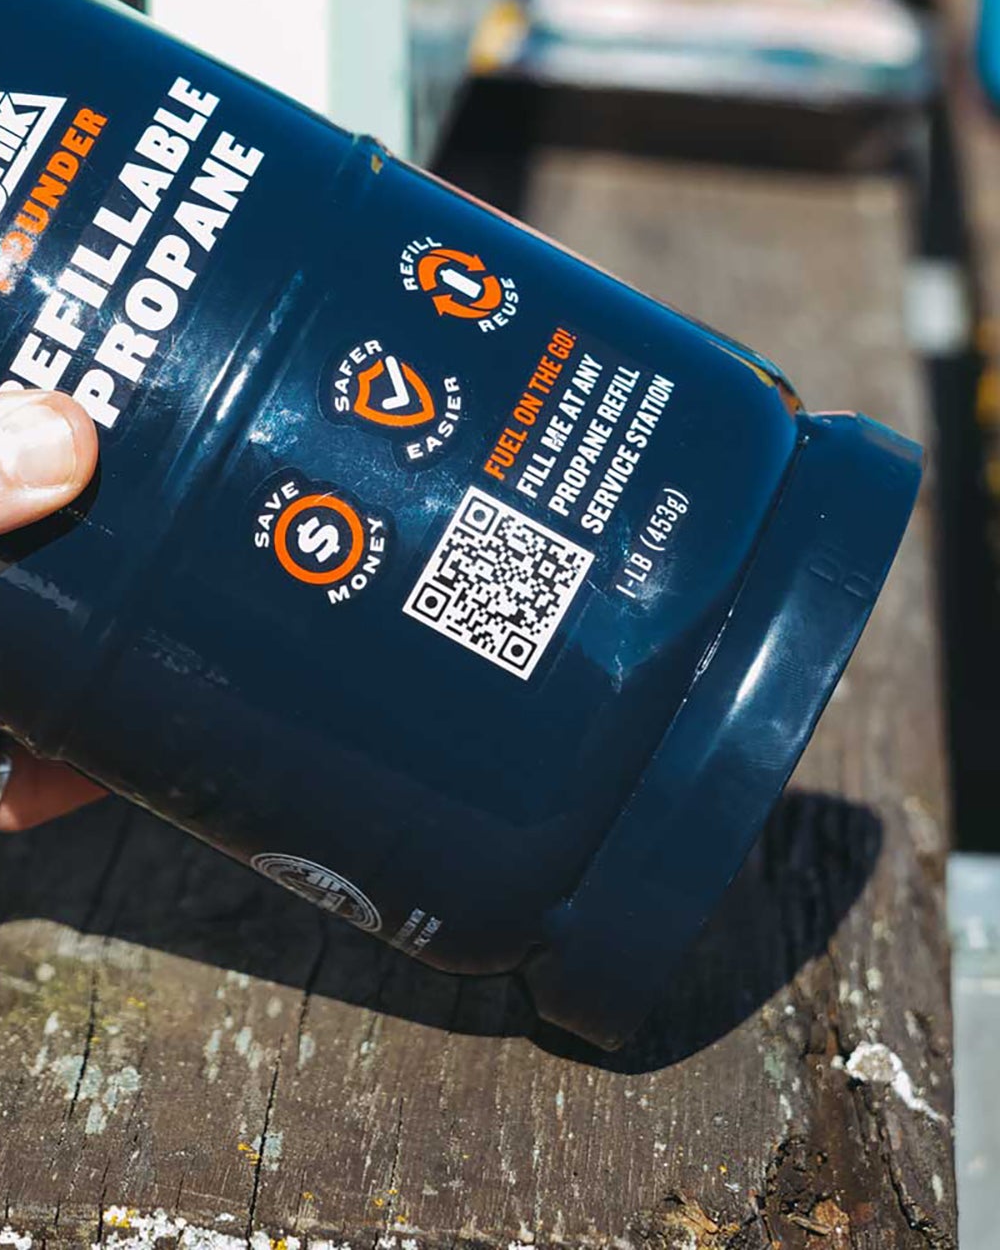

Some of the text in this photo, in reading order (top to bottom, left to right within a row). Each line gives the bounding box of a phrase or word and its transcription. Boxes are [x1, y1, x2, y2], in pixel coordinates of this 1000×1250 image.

[73, 132, 265, 428] PROPANE
[400, 236, 442, 290] REFILL
[478, 277, 519, 333] REUSE
[335, 339, 383, 412] SAFER
[407, 376, 461, 460] EASIER
[484, 328, 577, 481] FUEL ON THE GO!
[516, 354, 603, 498] FILL ME AT ANY
[548, 365, 640, 516] PROPANE REFILL
[581, 373, 675, 535] SERVICE STATION
[255, 481, 299, 548] SAVE
[639, 487, 690, 551] (453g)
[327, 517, 385, 605] MONEY
